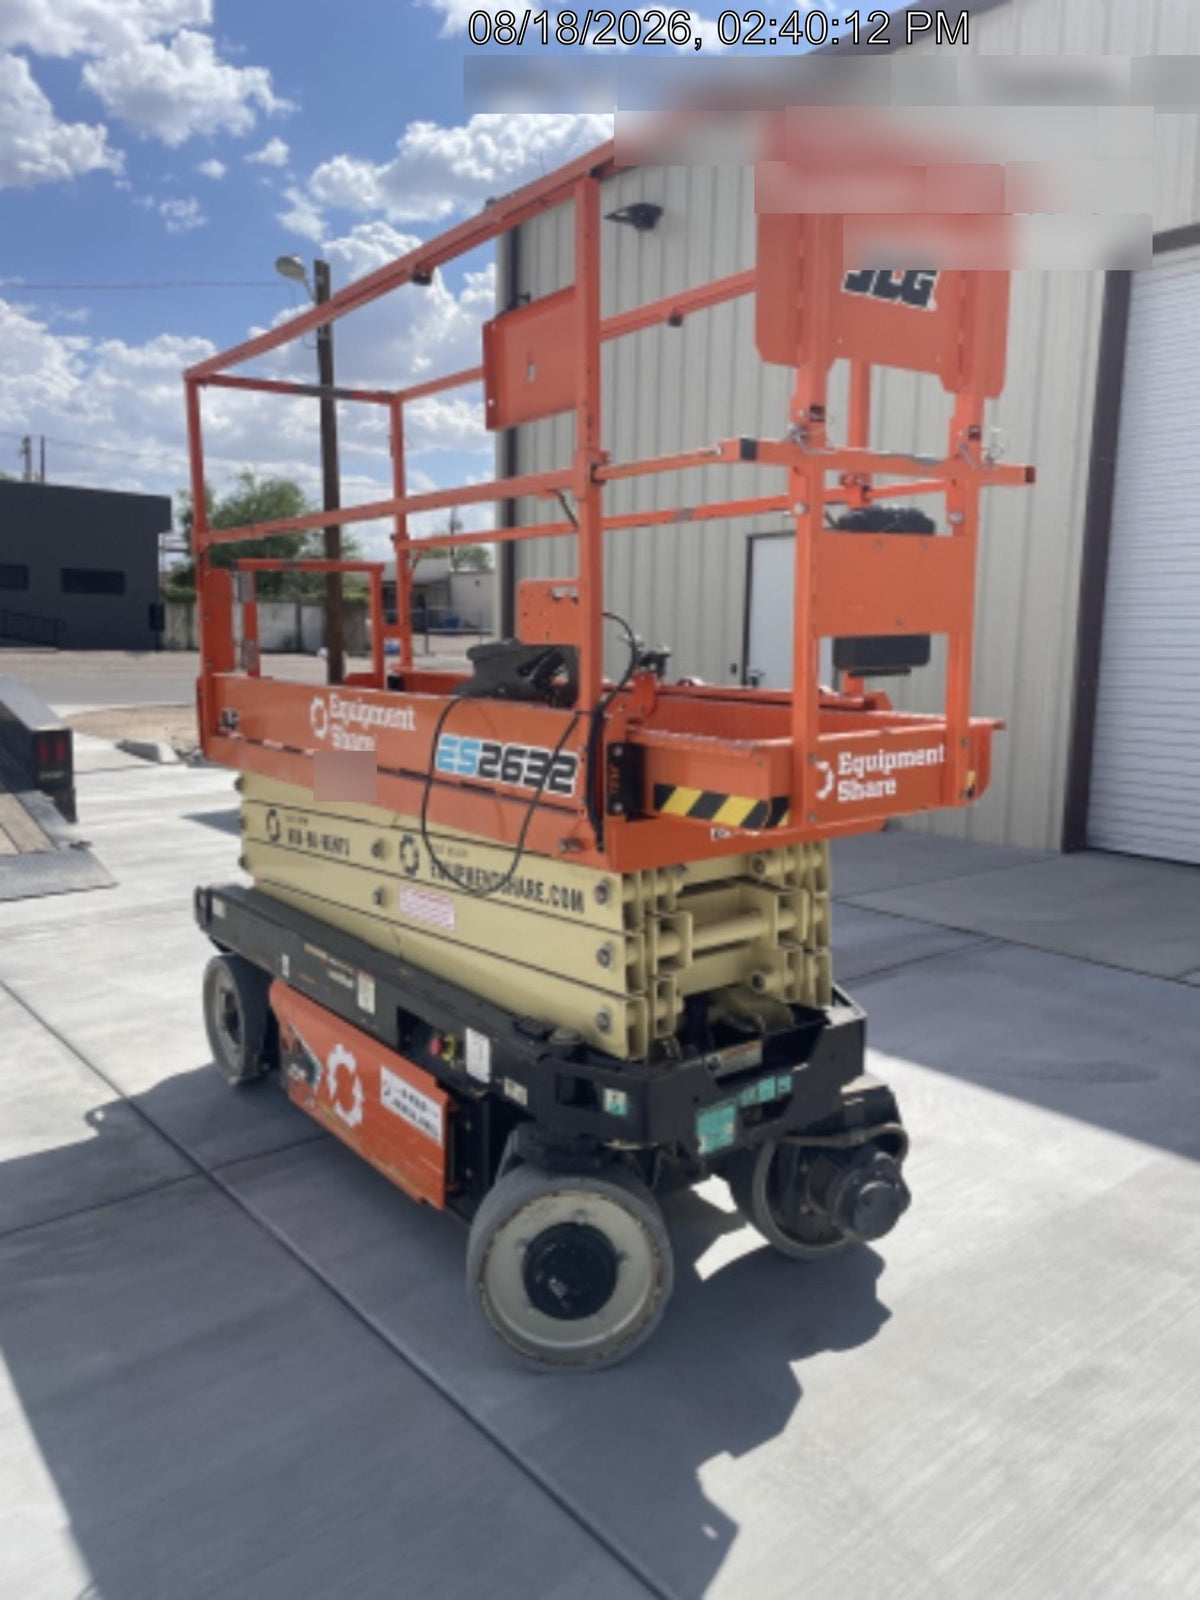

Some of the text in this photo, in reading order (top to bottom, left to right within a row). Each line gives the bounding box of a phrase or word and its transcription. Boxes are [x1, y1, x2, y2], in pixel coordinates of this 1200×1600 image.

[329, 693, 417, 731] Equipment
[437, 734, 579, 797] ES2632
[838, 743, 944, 778] Equipment
[837, 777, 897, 802] Share
